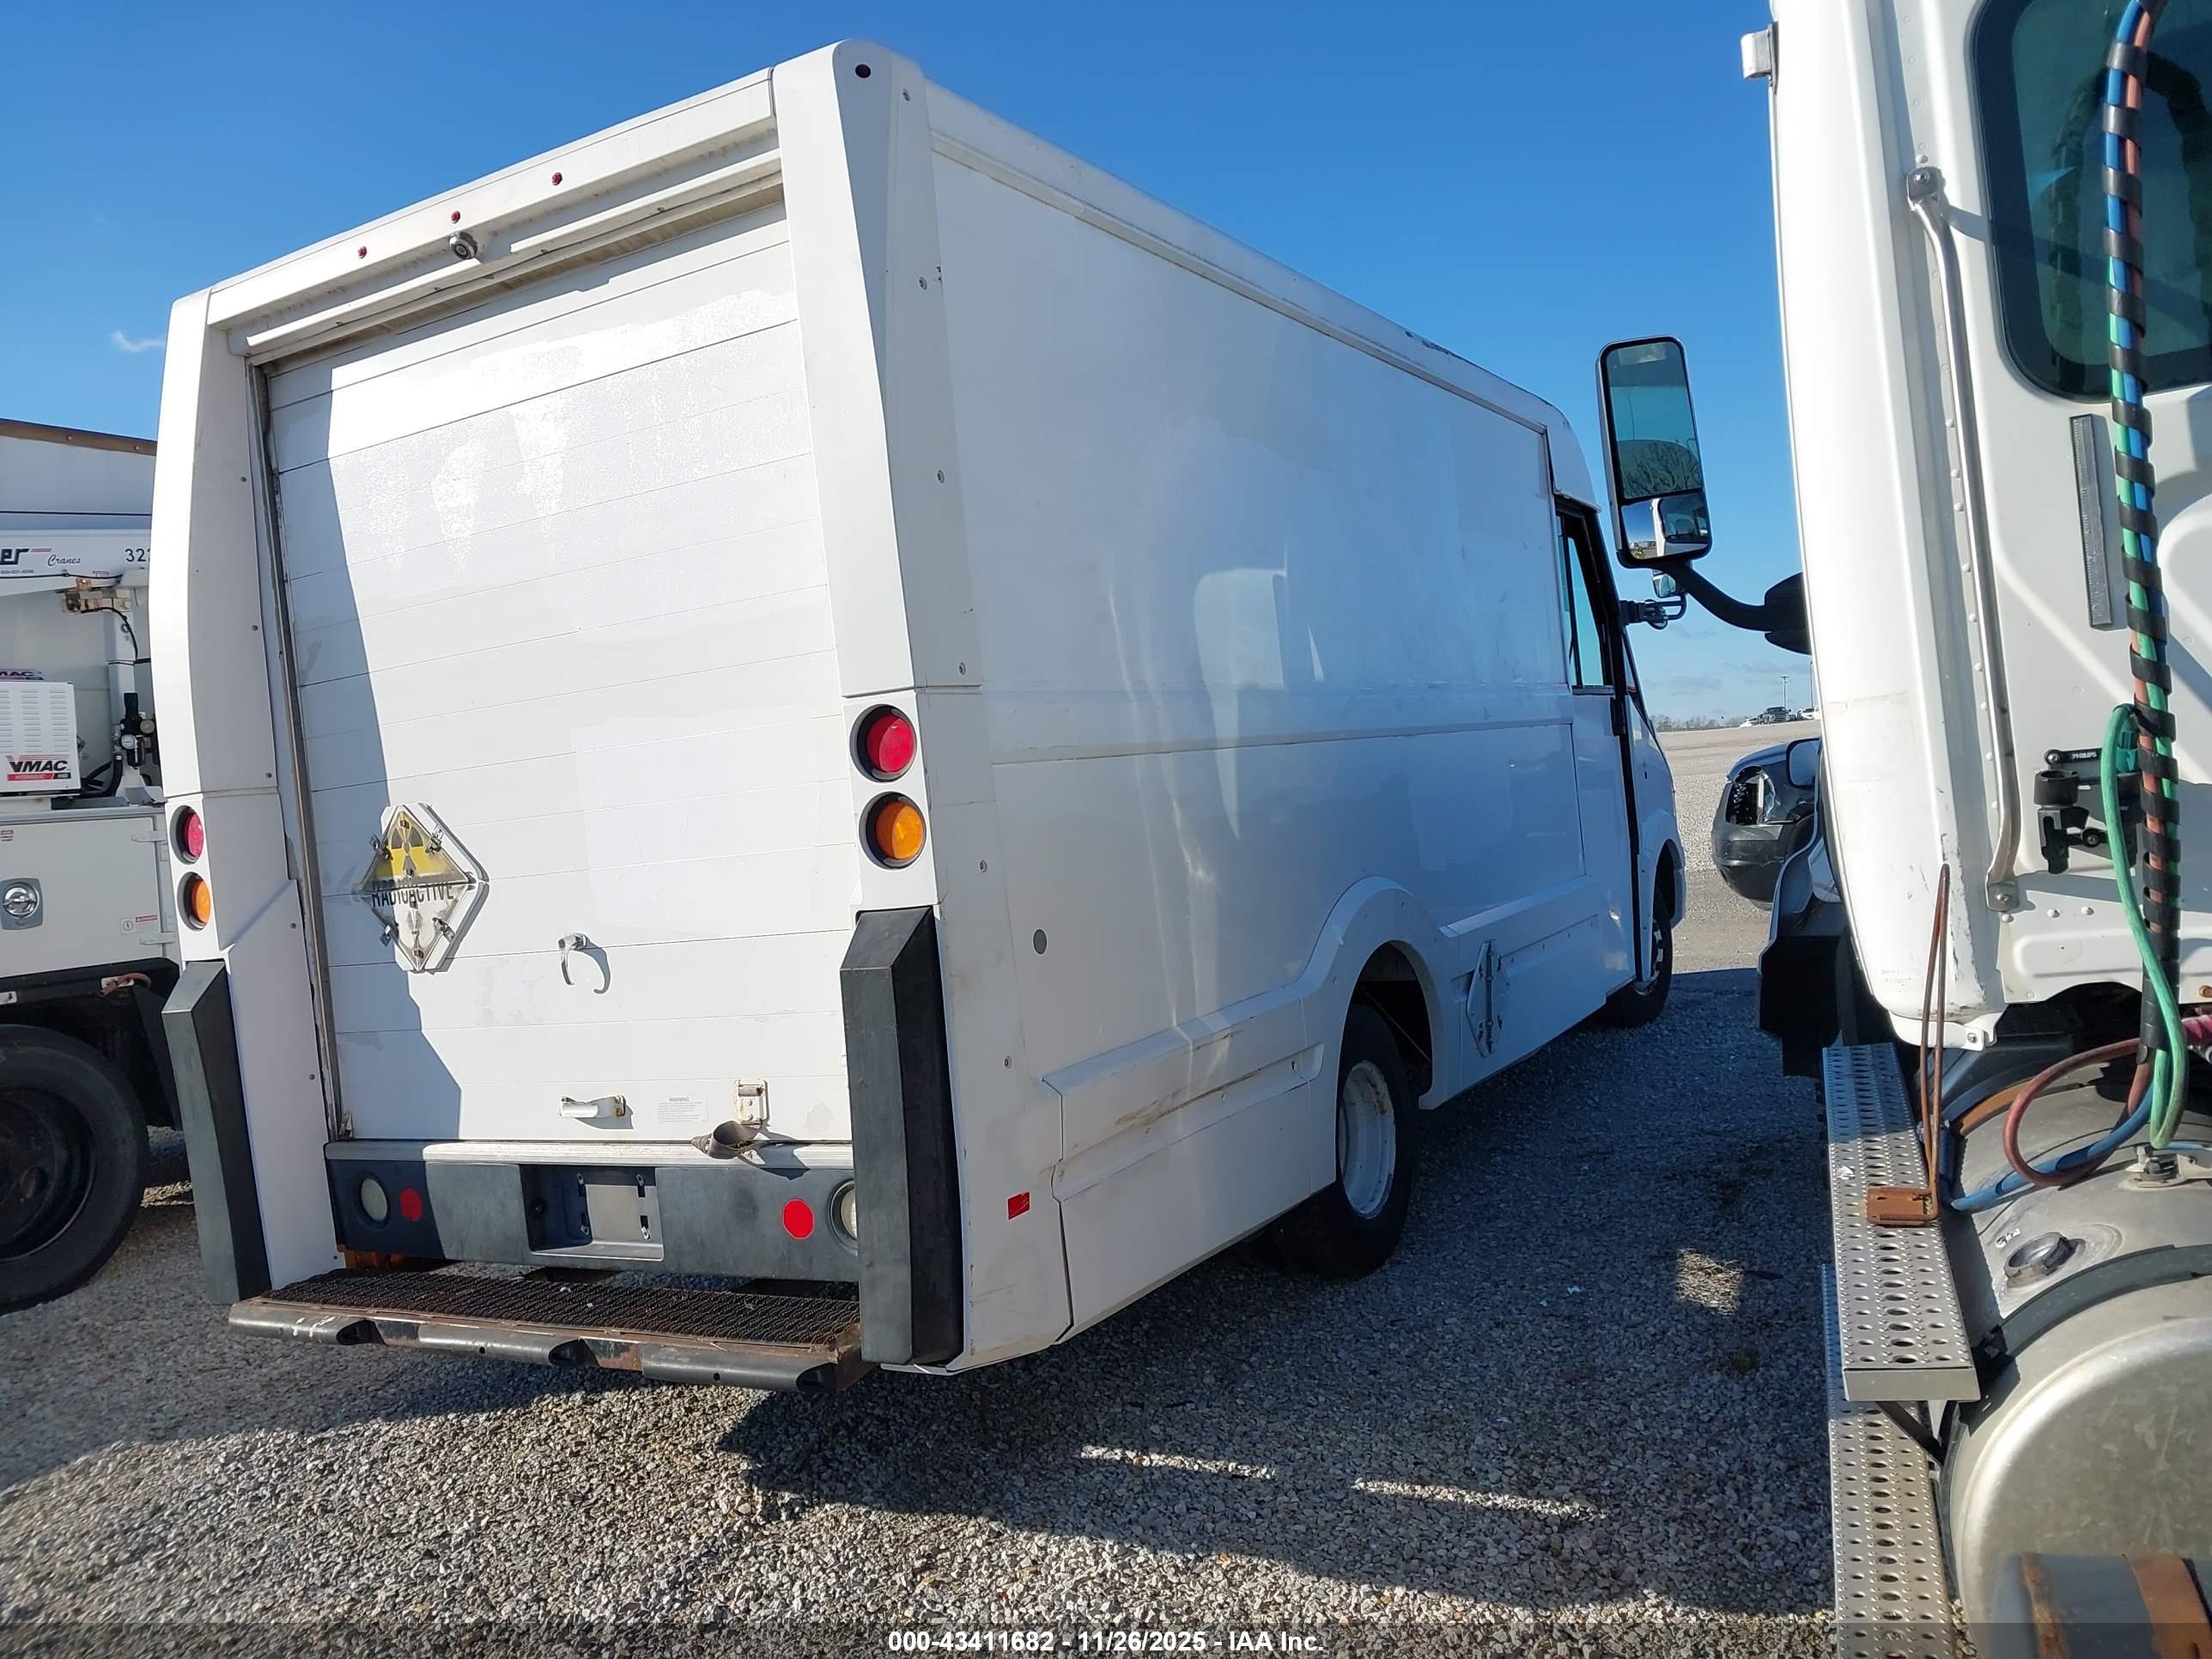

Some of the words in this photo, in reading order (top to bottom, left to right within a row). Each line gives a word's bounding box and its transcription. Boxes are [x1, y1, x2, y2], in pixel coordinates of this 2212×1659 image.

[47, 554, 81, 567] Cranes
[8, 760, 69, 773] VMAC
[371, 885, 454, 908] RADIOACTIVE
